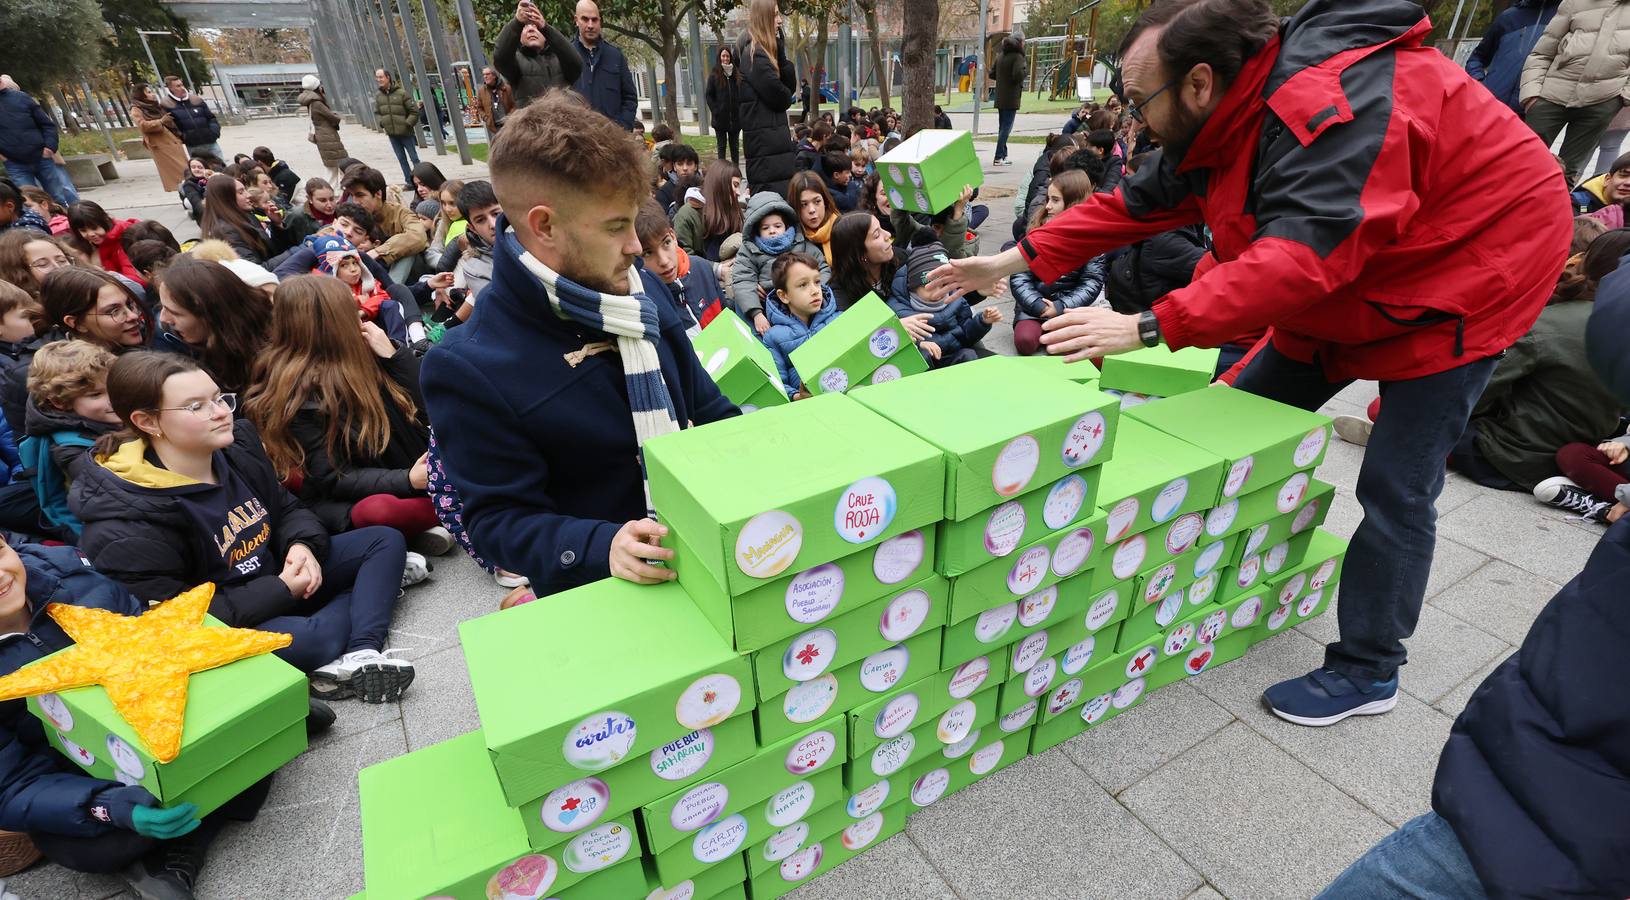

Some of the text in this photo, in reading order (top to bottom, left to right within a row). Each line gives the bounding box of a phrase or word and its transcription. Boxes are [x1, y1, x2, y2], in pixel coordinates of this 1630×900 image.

[848, 493, 875, 509] CRUZ
[846, 508, 881, 529] ROJA
[235, 555, 262, 575] EST
[798, 736, 825, 752] CRUZ
[797, 747, 825, 764] ROJA
[779, 785, 805, 803] SANTA
[686, 795, 716, 811] PUEBLO
[776, 795, 805, 815] MARTA
[701, 822, 745, 850] CÁRITAS
[704, 848, 718, 857] SAN
